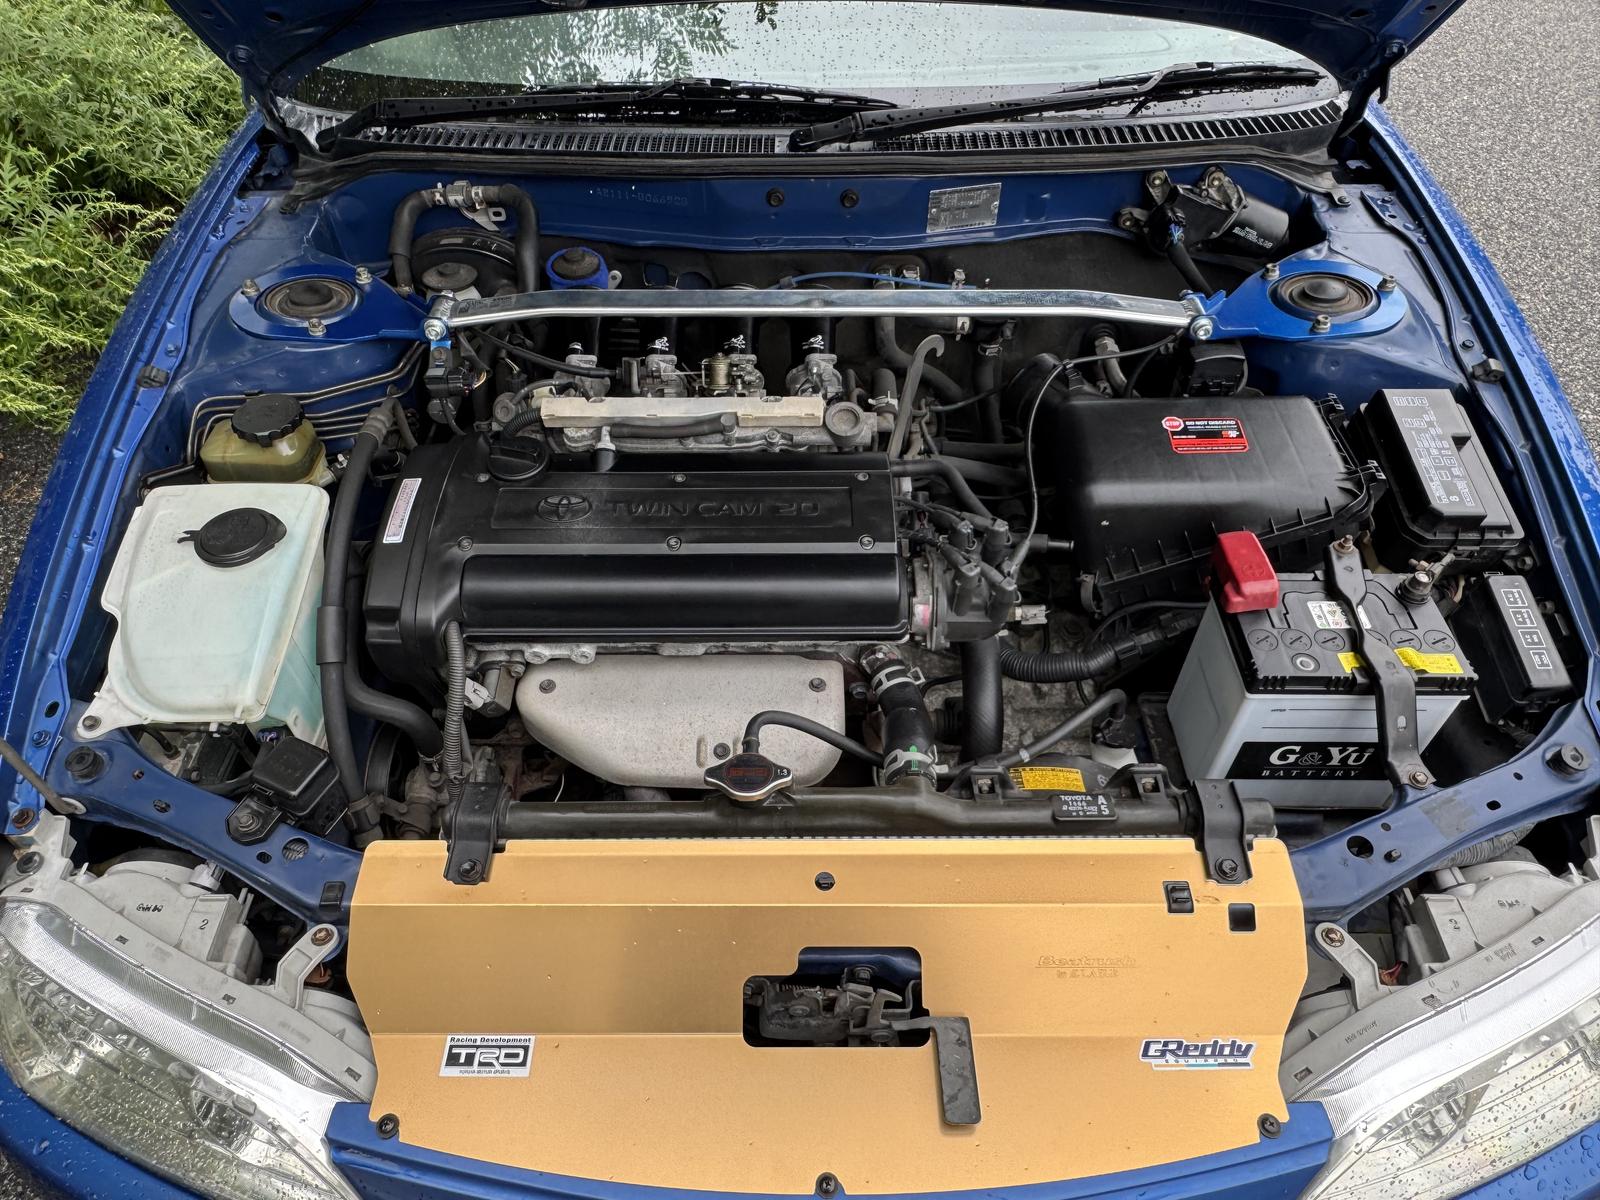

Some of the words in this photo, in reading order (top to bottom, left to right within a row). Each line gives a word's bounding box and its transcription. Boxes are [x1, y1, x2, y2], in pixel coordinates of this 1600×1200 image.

[607, 501, 689, 517] TWIN
[699, 501, 763, 517] CAM
[1098, 795, 1108, 805] A
[1101, 805, 1110, 815] 5
[1141, 1040, 1254, 1058] GReddy
[451, 1047, 525, 1069] TRD
